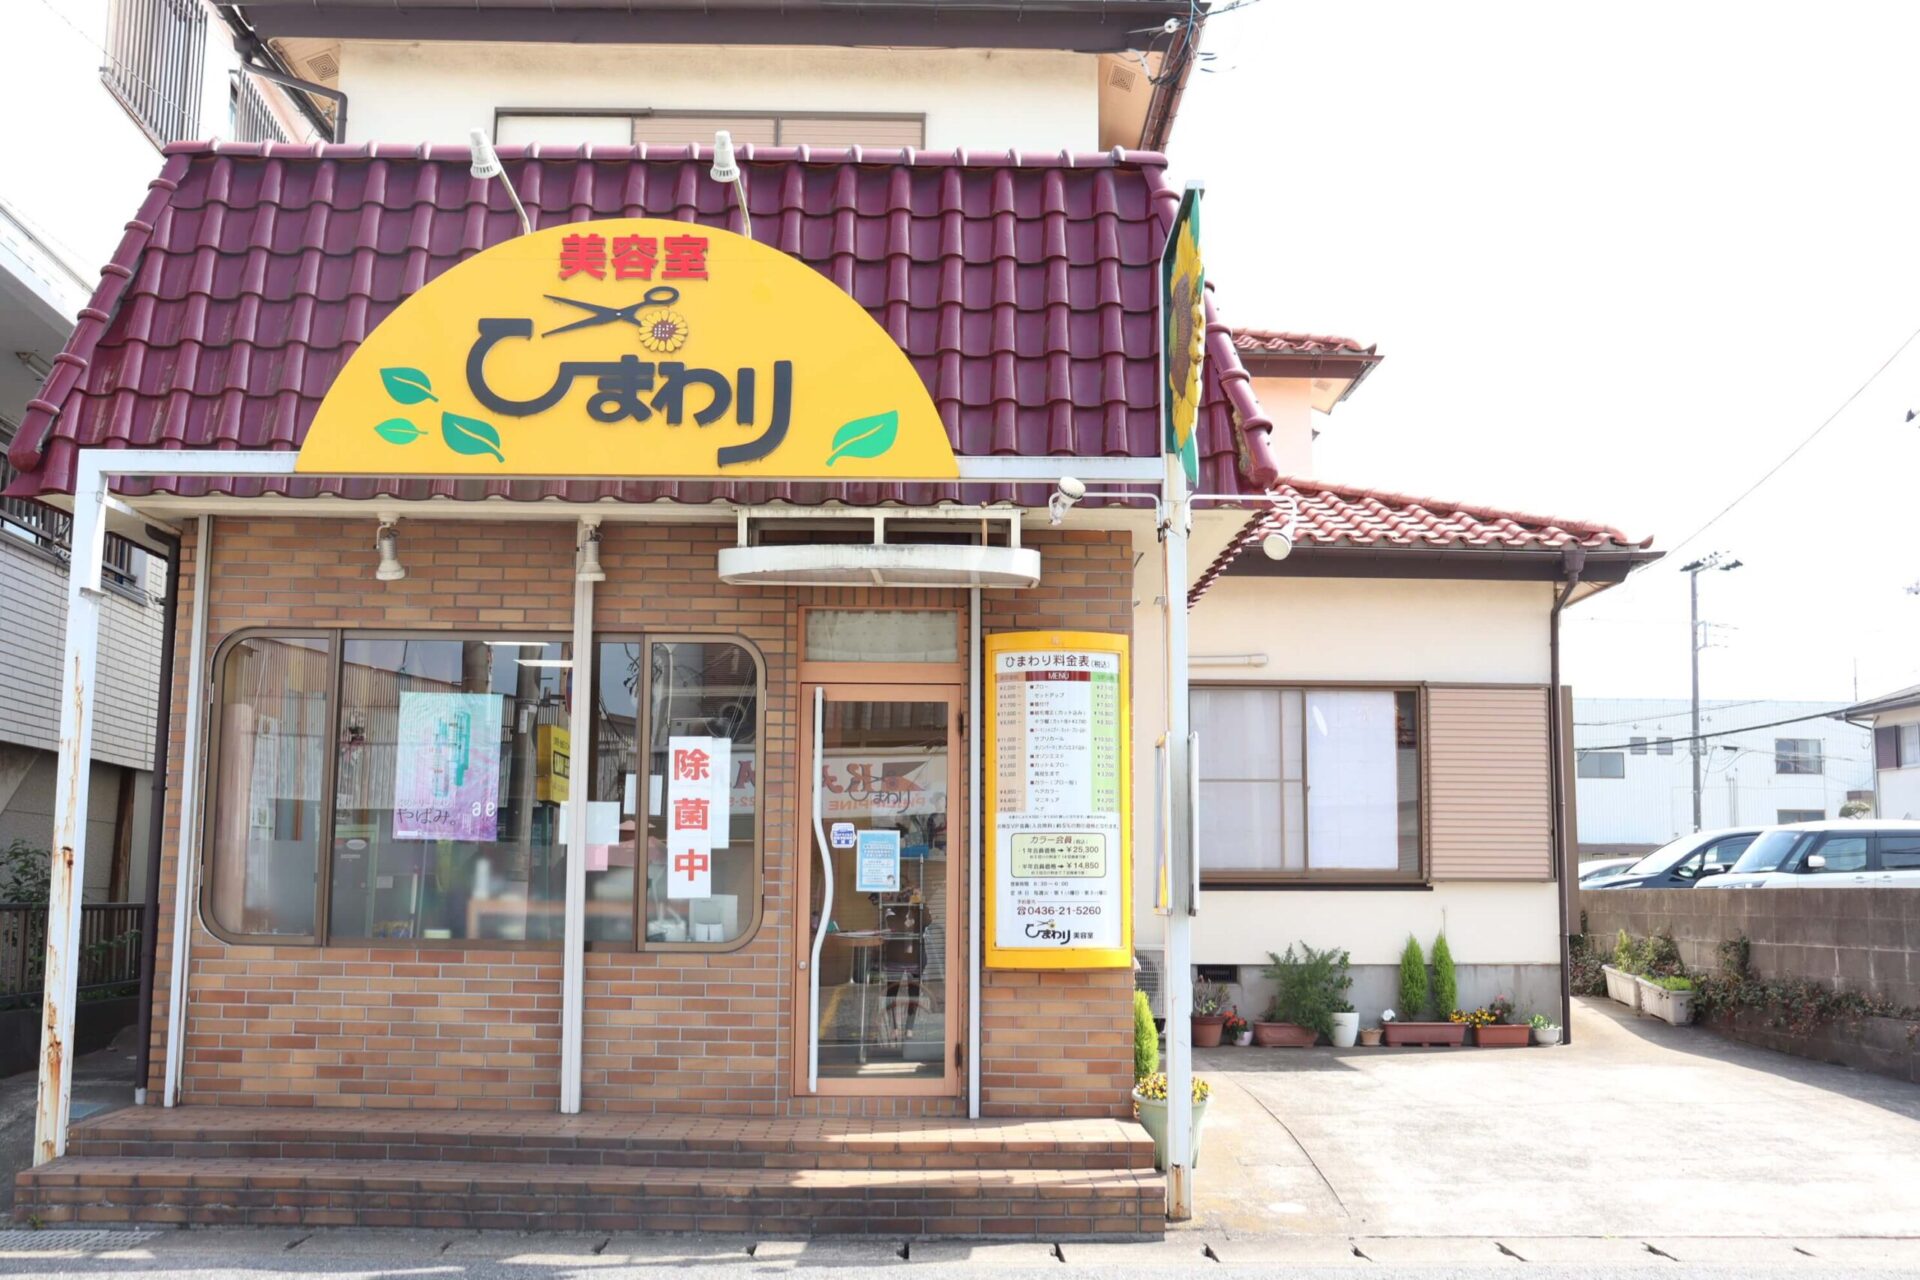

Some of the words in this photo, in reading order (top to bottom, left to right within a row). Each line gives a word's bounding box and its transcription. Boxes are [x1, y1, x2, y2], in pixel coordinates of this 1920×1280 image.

[559, 234, 709, 281] 美容室
[466, 317, 792, 468] ひまわり
[1005, 654, 1090, 668] ひまわり料金表
[1048, 672, 1070, 680] MENU
[673, 748, 710, 881] 除菌中
[1030, 836, 1073, 844] カラー会員
[1067, 846, 1099, 854] ¥25,300
[1067, 862, 1099, 870] ¥14,850
[1028, 906, 1101, 915] 0436-21-5260
[1025, 923, 1071, 945] ひまわり
[1073, 931, 1094, 940] 美容室
